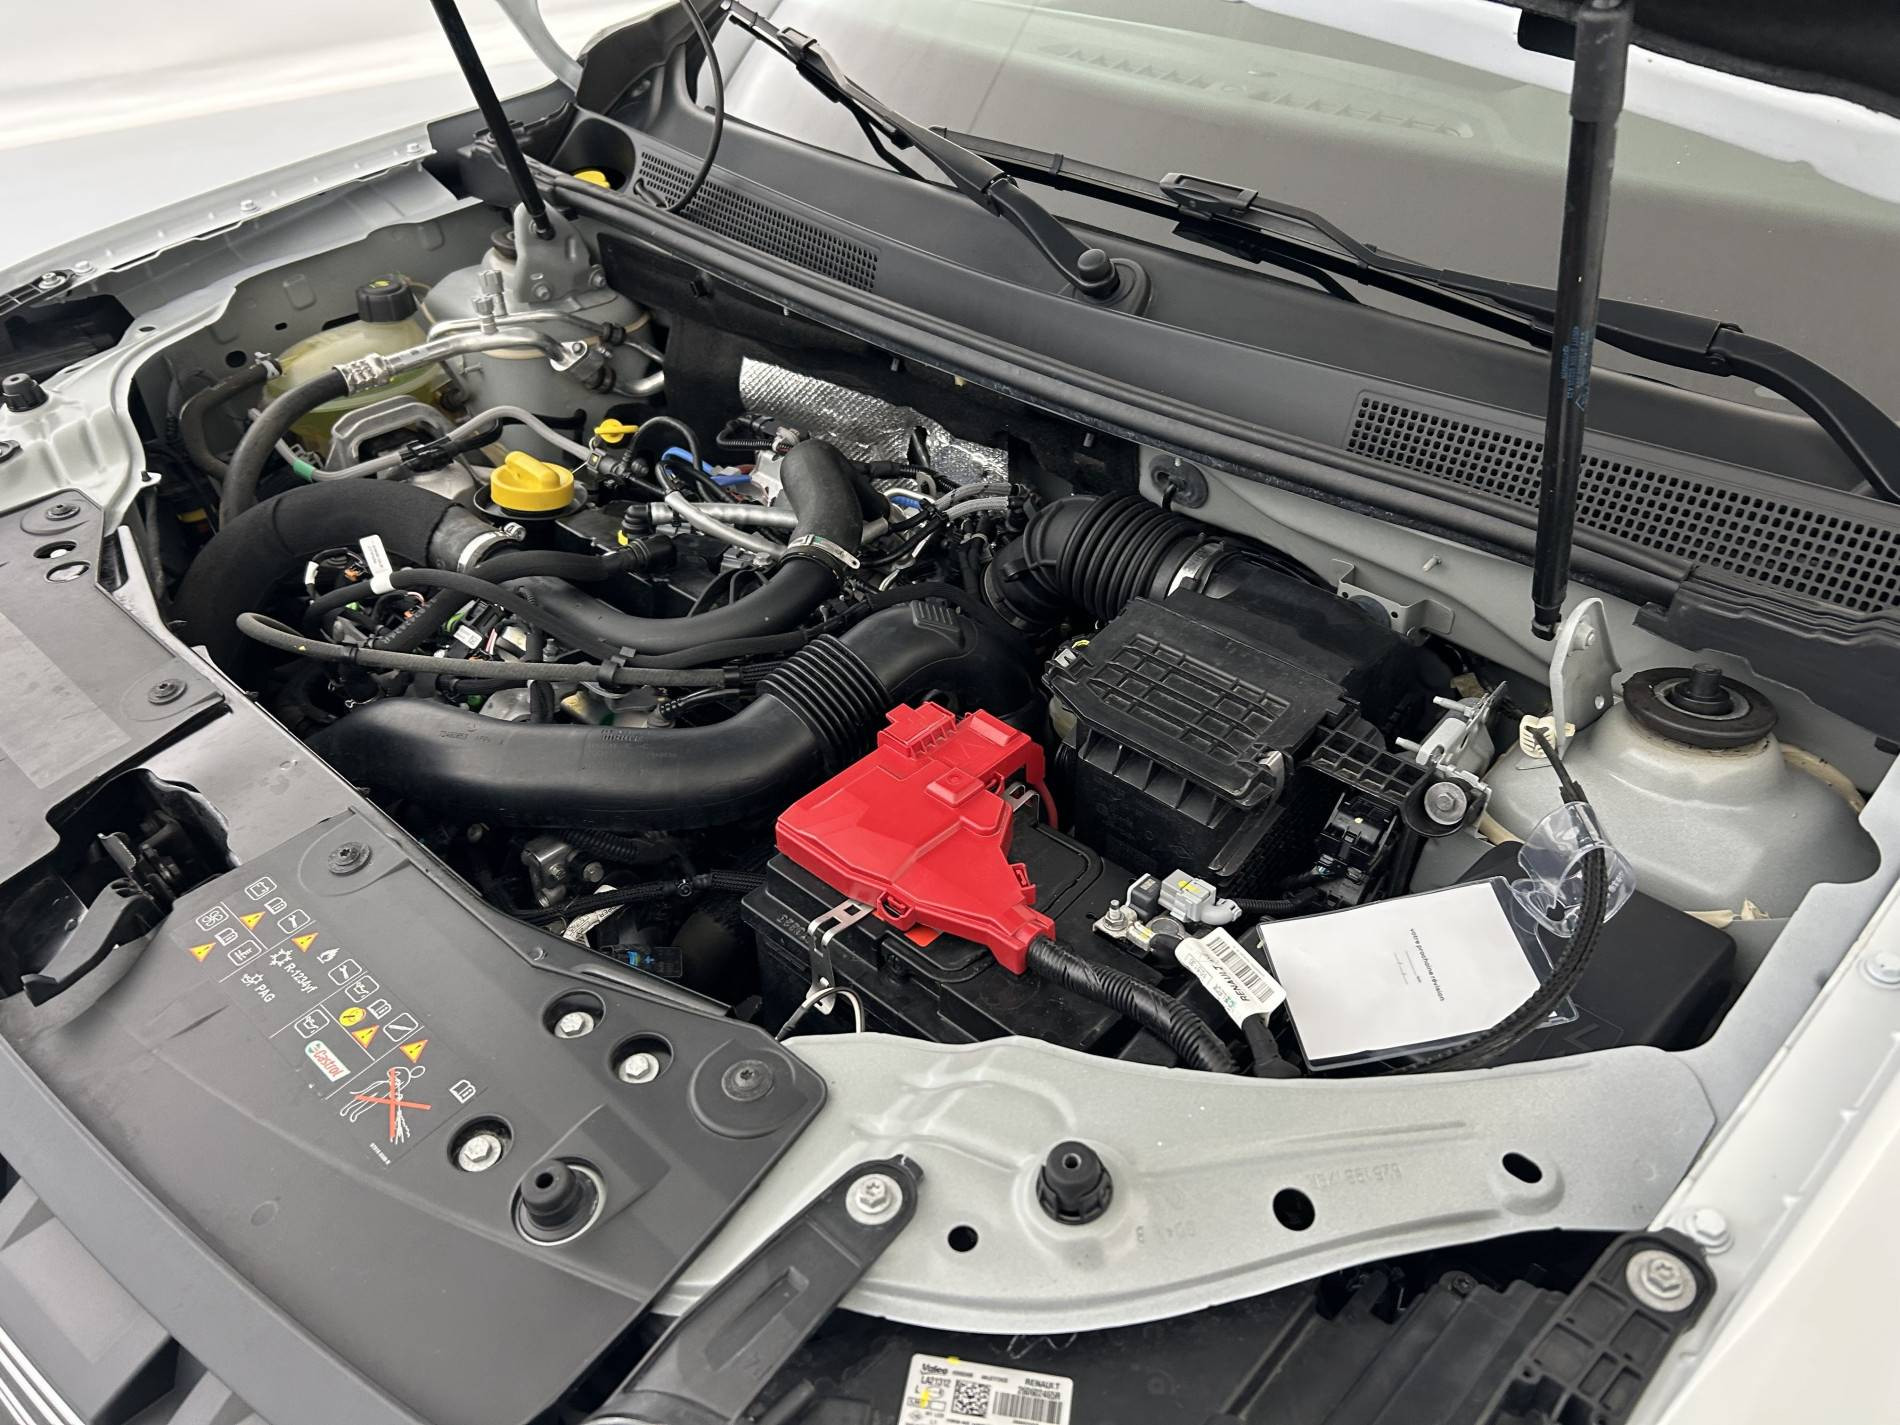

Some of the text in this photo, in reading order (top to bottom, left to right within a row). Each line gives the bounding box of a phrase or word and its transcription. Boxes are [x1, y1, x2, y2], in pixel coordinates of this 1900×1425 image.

[283, 962, 318, 994] R-1234yf
[1409, 928, 1420, 945] votre
[1415, 945, 1434, 976] prochaine
[1431, 975, 1445, 1001] révision
[254, 983, 276, 1003] PAG
[1212, 964, 1250, 1001] RENAULT
[313, 1049, 345, 1078] Castrol
[1024, 1377, 1060, 1389] RENAULT
